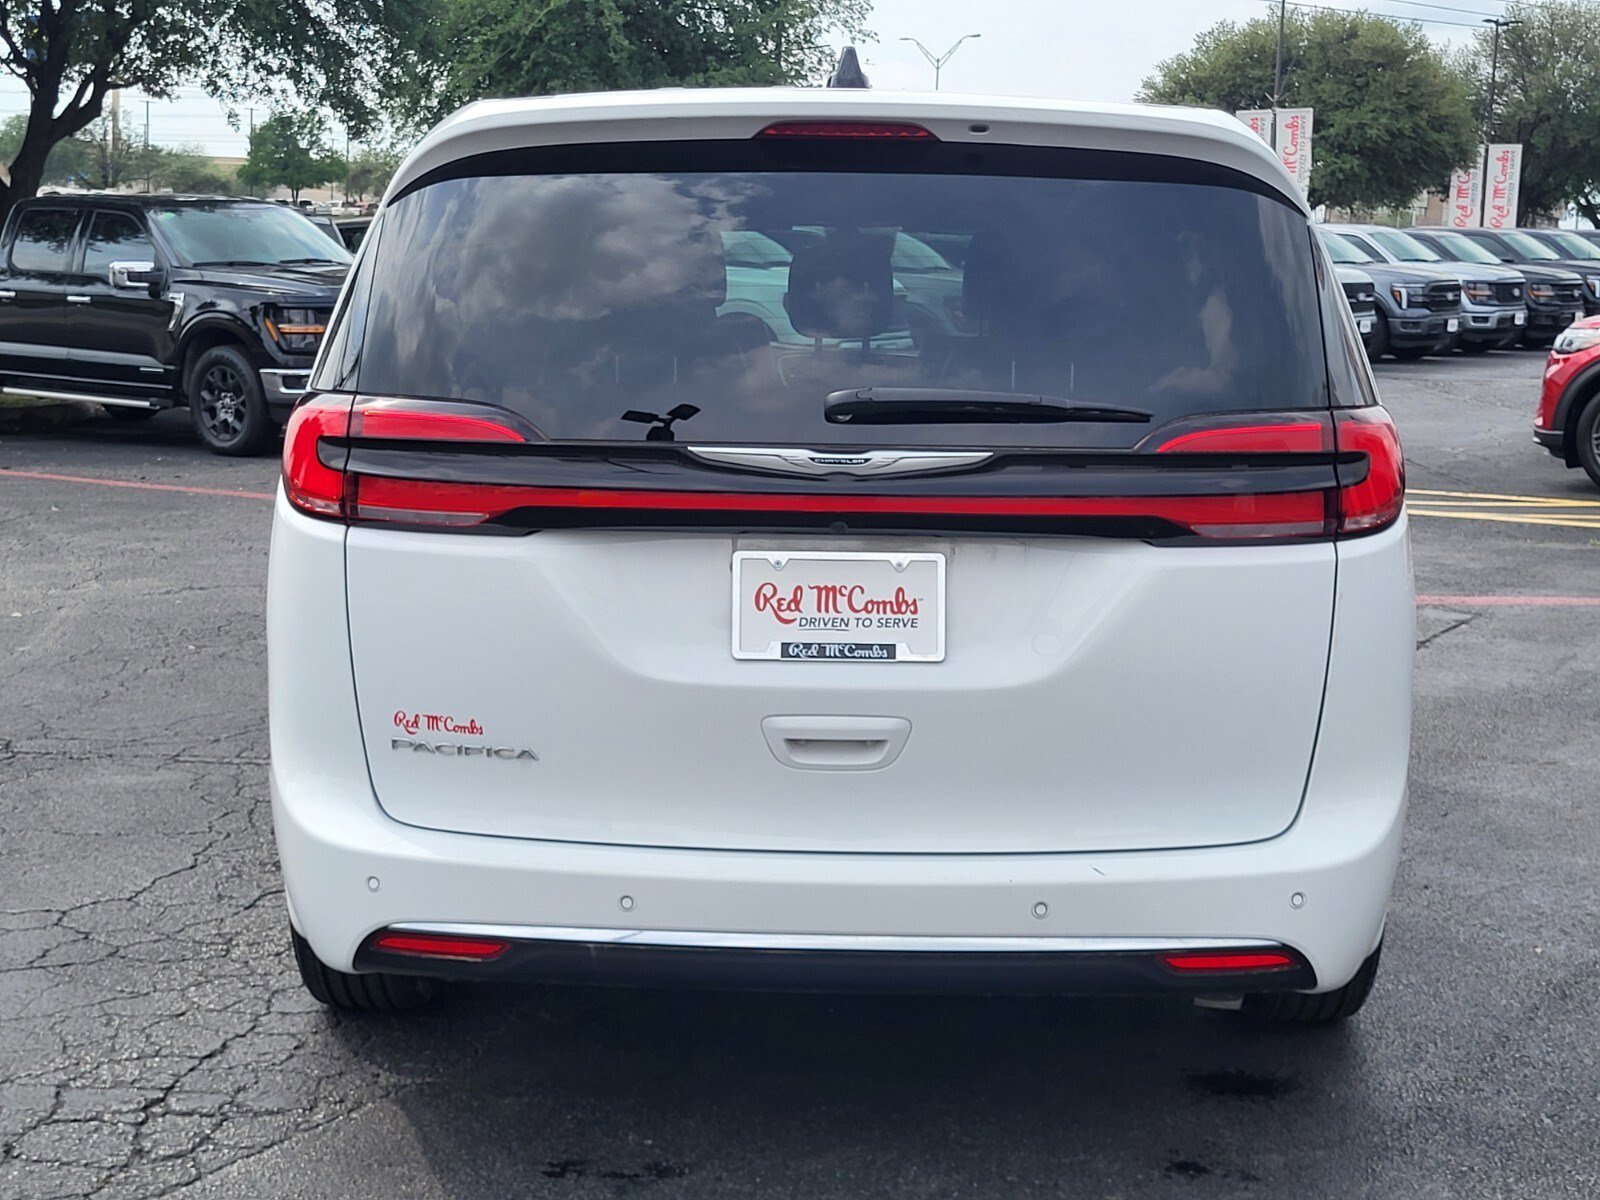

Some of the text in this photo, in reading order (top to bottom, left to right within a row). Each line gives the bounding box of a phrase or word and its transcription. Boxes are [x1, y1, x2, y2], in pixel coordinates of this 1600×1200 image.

[1453, 170, 1474, 228] Red McCo
[1489, 150, 1510, 229] Red McCombs
[754, 582, 803, 625] Red
[798, 616, 919, 629] DRIVEN TO SERVE
[788, 643, 888, 658] Red McCombs
[393, 710, 484, 736] Red McCombs
[391, 736, 540, 761] PACIFICA
